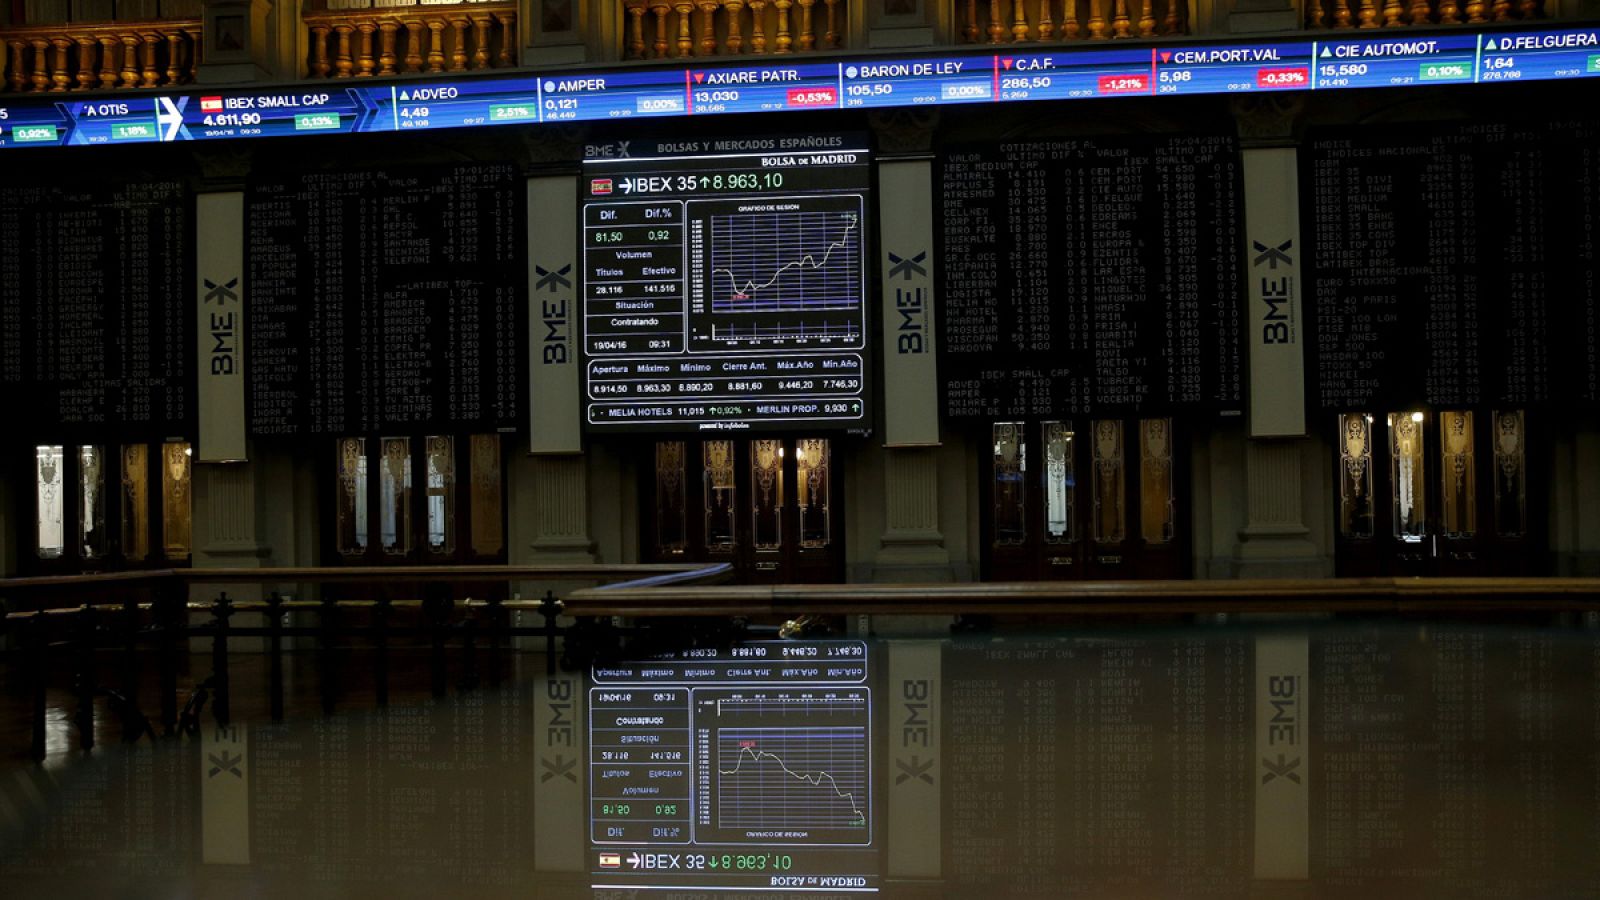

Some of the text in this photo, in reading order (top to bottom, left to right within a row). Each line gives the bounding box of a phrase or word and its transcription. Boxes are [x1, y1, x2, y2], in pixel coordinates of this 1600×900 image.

[1500, 32, 1598, 50] D.FELGUERA
[1335, 41, 1440, 57] CIE AUTOMOT.
[1174, 48, 1281, 64] CEM.PORT.VAL
[860, 62, 963, 78] BARON DE LEY
[1015, 58, 1056, 71] C.A.F.
[1319, 63, 1368, 77] 15,580
[1483, 57, 1514, 71] 1,64
[707, 70, 801, 85] AXIARE PATR.
[1159, 70, 1191, 83] 5,98
[1427, 65, 1463, 77] 0,10%
[1002, 76, 1051, 89] 286,50
[1105, 79, 1142, 90] -1,21%
[1262, 72, 1304, 84] -0,33%
[558, 79, 606, 92] AMPER
[846, 83, 893, 96] 105,50
[948, 85, 984, 96] 0,00%
[412, 87, 458, 100] ADVEO
[694, 91, 739, 103] 13,030
[791, 92, 832, 103] -0,53%
[225, 94, 329, 109] IBEX SMALL CAP
[545, 99, 578, 111] 0,121
[643, 99, 678, 110] 0,00%
[99, 103, 129, 115] OTIS
[401, 107, 429, 119] 4,49
[497, 107, 529, 118] 2,51%
[203, 113, 261, 126] 4.611,90
[302, 117, 333, 127] 0,13%
[18, 129, 51, 138] 0,92%
[120, 126, 147, 136] 1,18%
[657, 142, 699, 153] BOLSAS
[703, 142, 710, 151] Y
[714, 139, 775, 150] MERCADOS
[779, 136, 842, 149] ESPAÑOLES
[761, 157, 796, 167] BOLSA
[810, 154, 857, 165] MADRID
[632, 173, 784, 192] IBEX 35 8.963,10
[600, 207, 672, 220] Dif. Dif.%
[595, 231, 623, 242] 81,50
[648, 230, 670, 241] 0,92
[642, 267, 676, 276] Efectivo
[615, 300, 654, 310] Situación
[1261, 276, 1289, 344] BME
[611, 317, 659, 327] Contratando
[896, 287, 923, 354] BME
[542, 299, 567, 365] BME
[210, 311, 233, 376] BME
[593, 341, 627, 350] 19/04/16
[648, 340, 671, 349] 09:31
[592, 365, 629, 375] Apertura
[722, 362, 748, 371] Cierre
[749, 362, 767, 370] Ant.
[608, 406, 742, 417] MELIA HOTELS 11,015 0,92%
[756, 404, 848, 414] MERLIN PROP. 9,930
